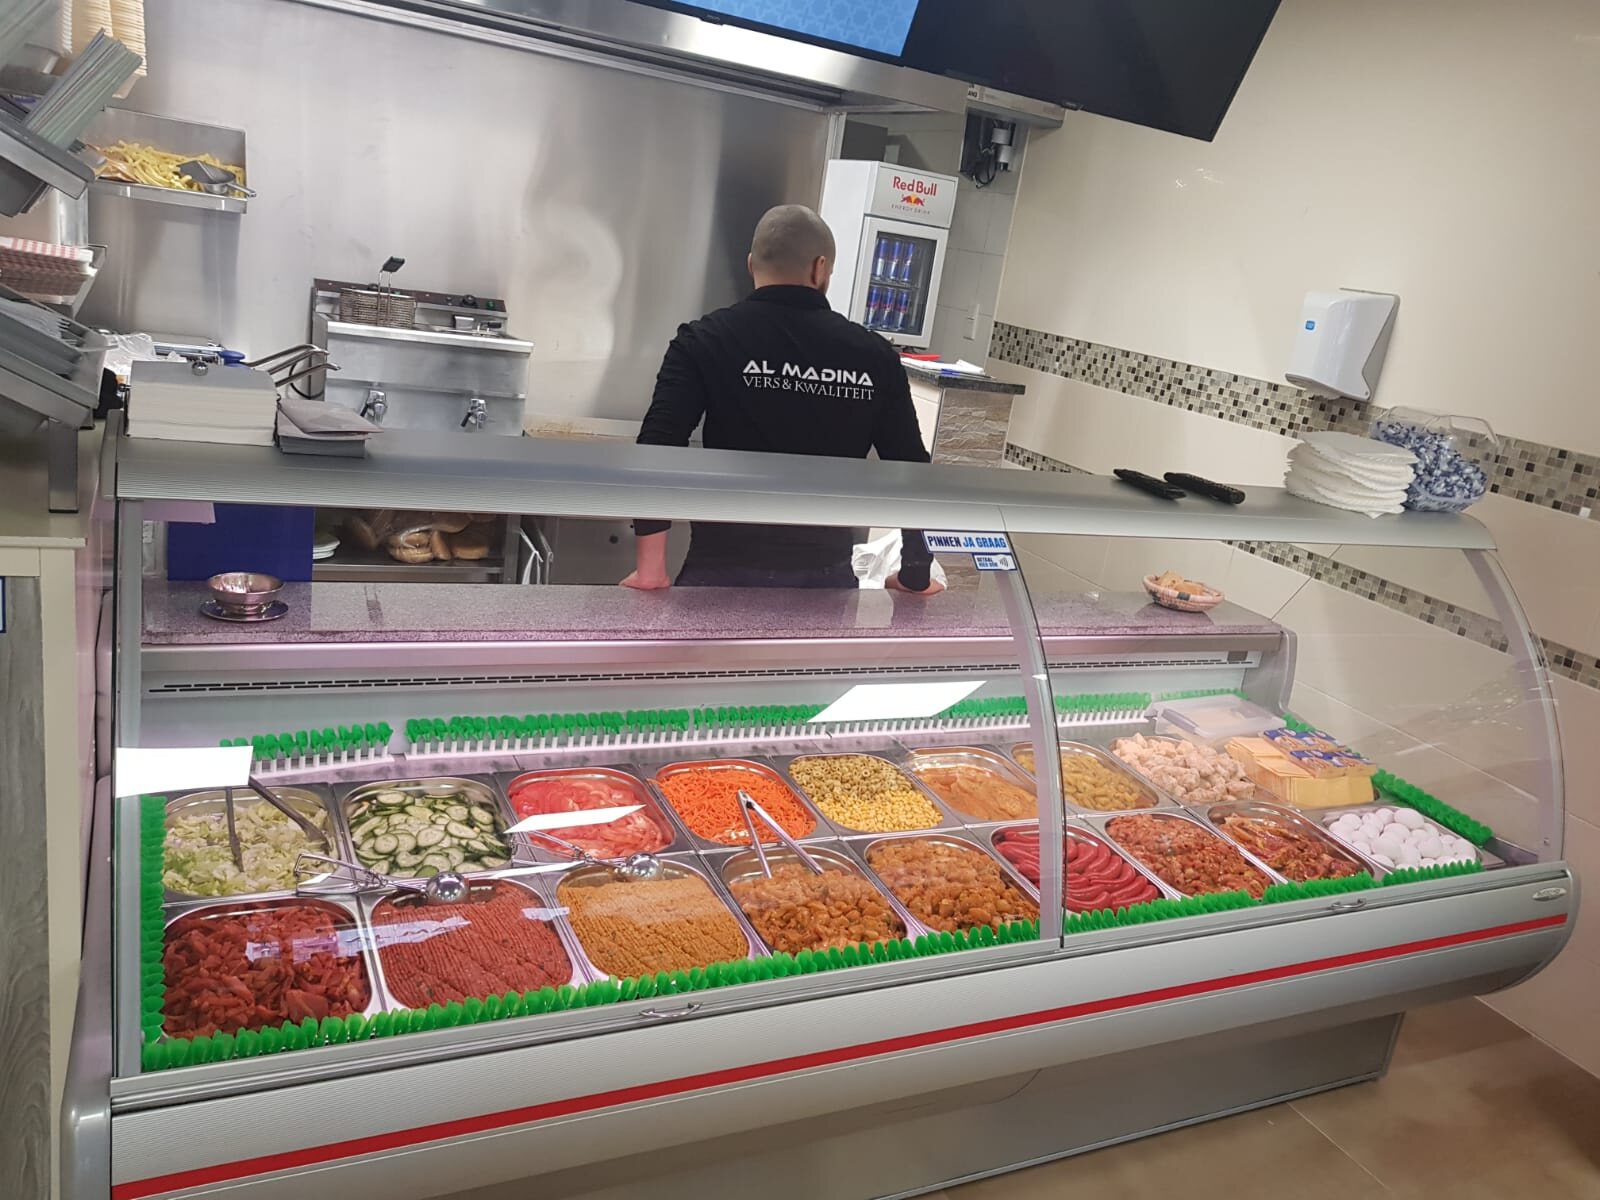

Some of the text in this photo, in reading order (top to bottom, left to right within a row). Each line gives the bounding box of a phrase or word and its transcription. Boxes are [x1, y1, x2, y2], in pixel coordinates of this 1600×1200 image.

[893, 176, 937, 196] Red Bull
[743, 360, 874, 386] AL MADINA
[927, 535, 1007, 548] PINNEN JA GRAAG
